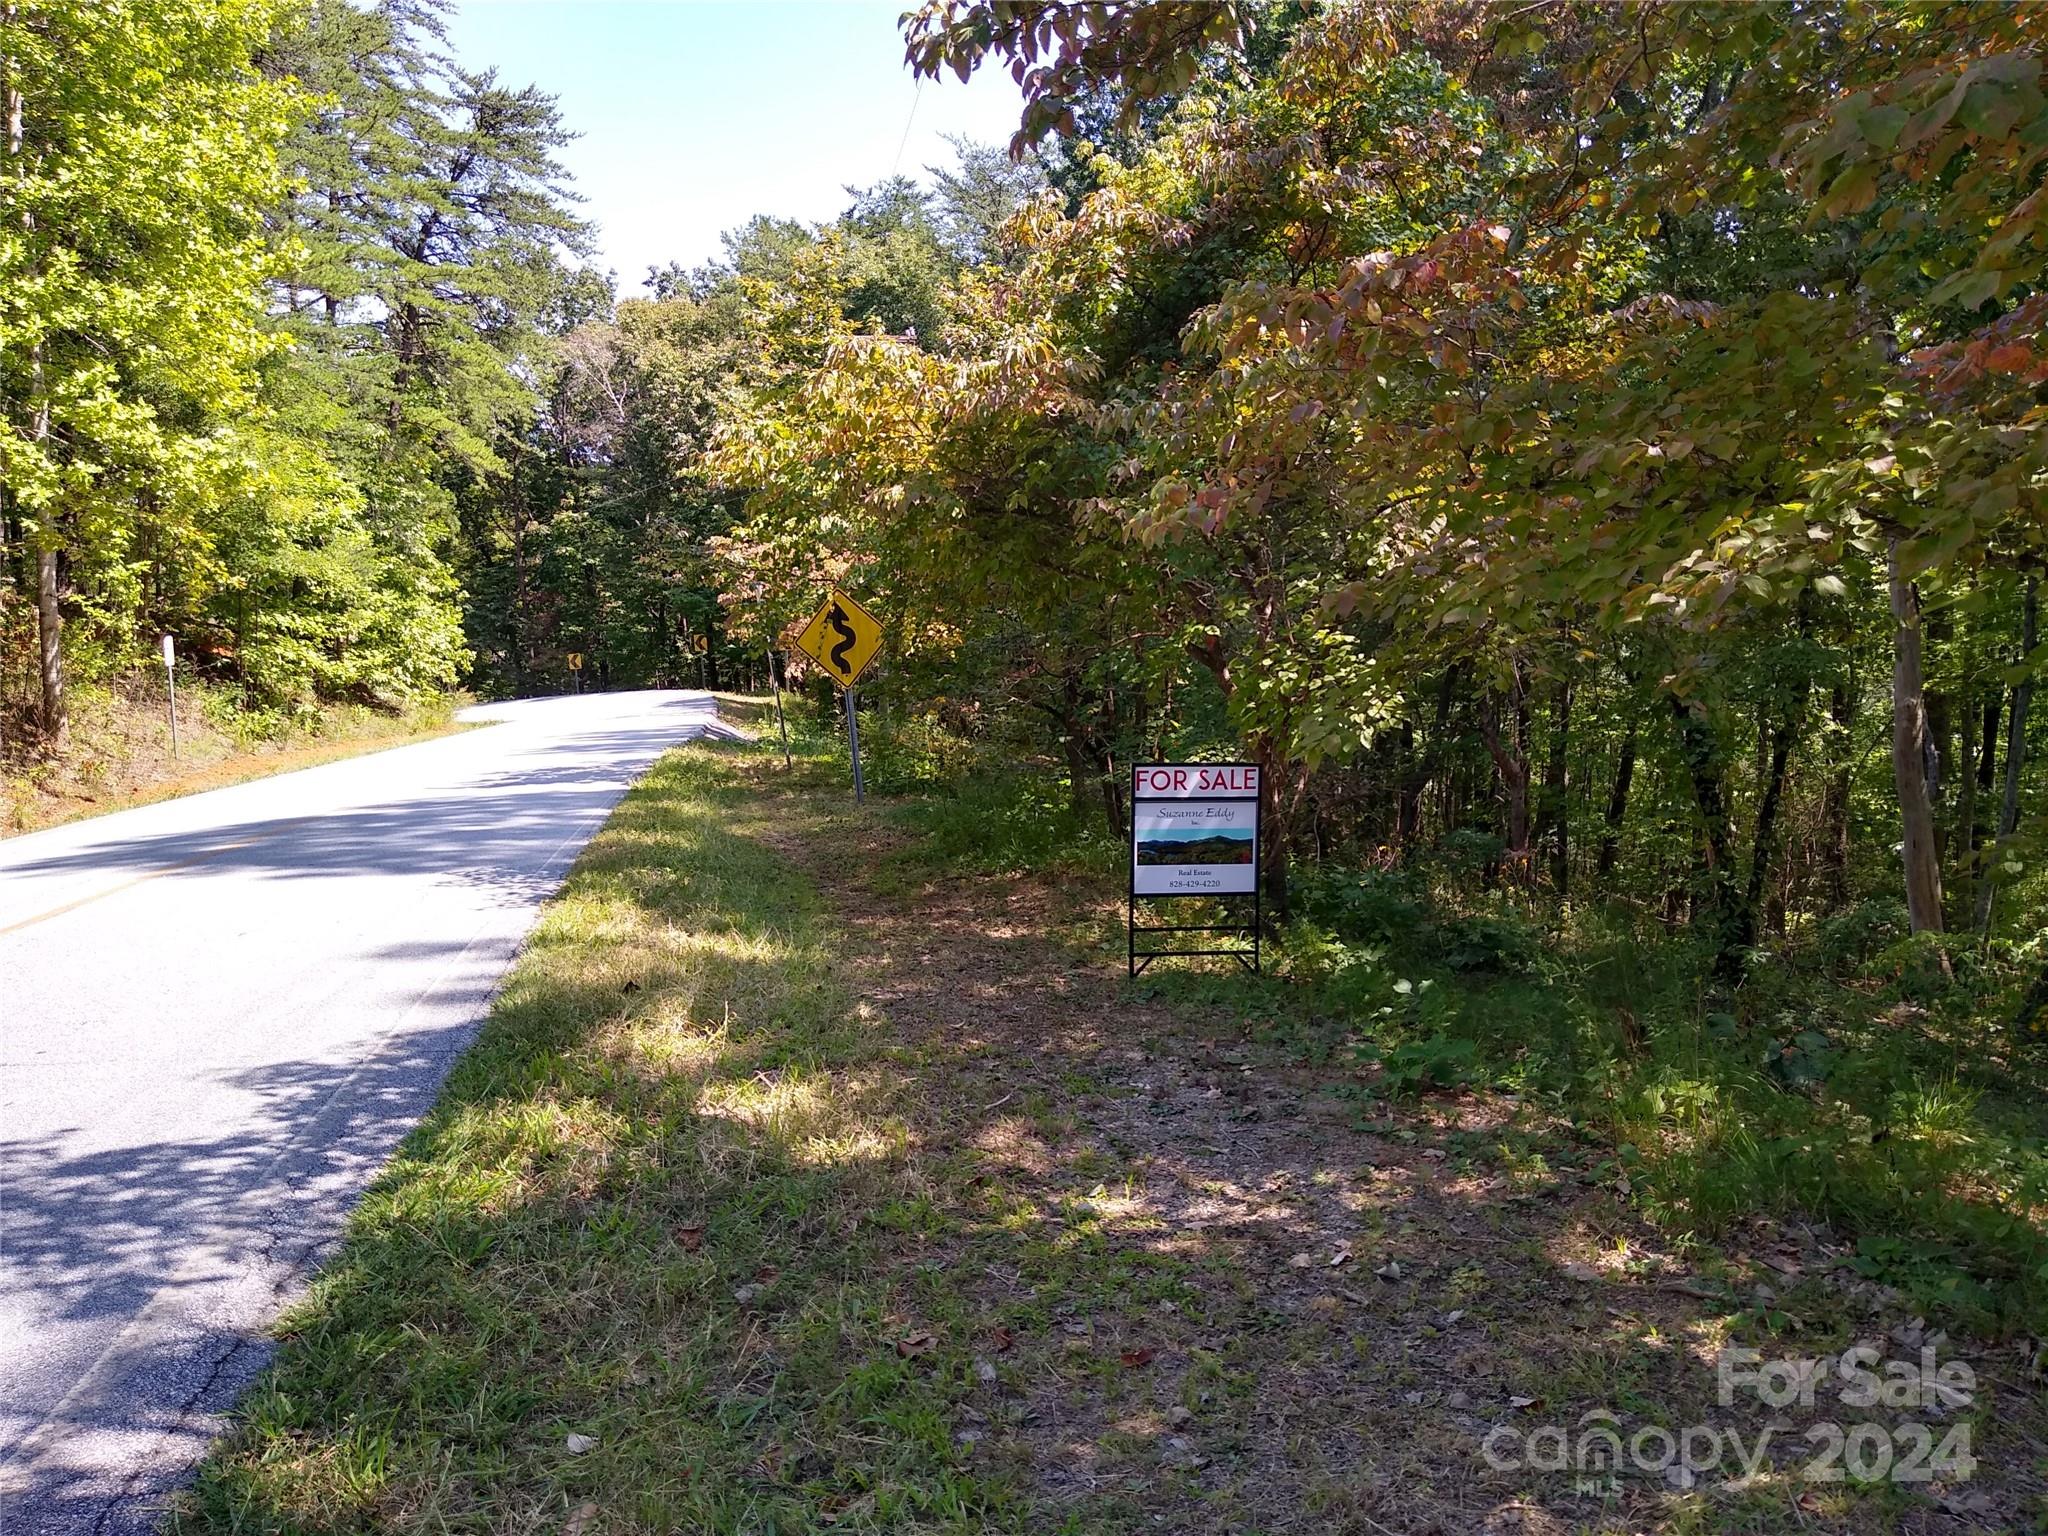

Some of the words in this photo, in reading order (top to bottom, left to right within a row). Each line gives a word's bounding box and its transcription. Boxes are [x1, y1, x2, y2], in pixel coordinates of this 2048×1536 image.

[1136, 770, 1188, 791] FOR
[1199, 769, 1256, 790] SALE
[1156, 808, 1204, 818] Suzanne
[1206, 808, 1234, 821] Eddy
[1178, 869, 1192, 877] Real
[1169, 880, 1220, 888] 828-429-4220
